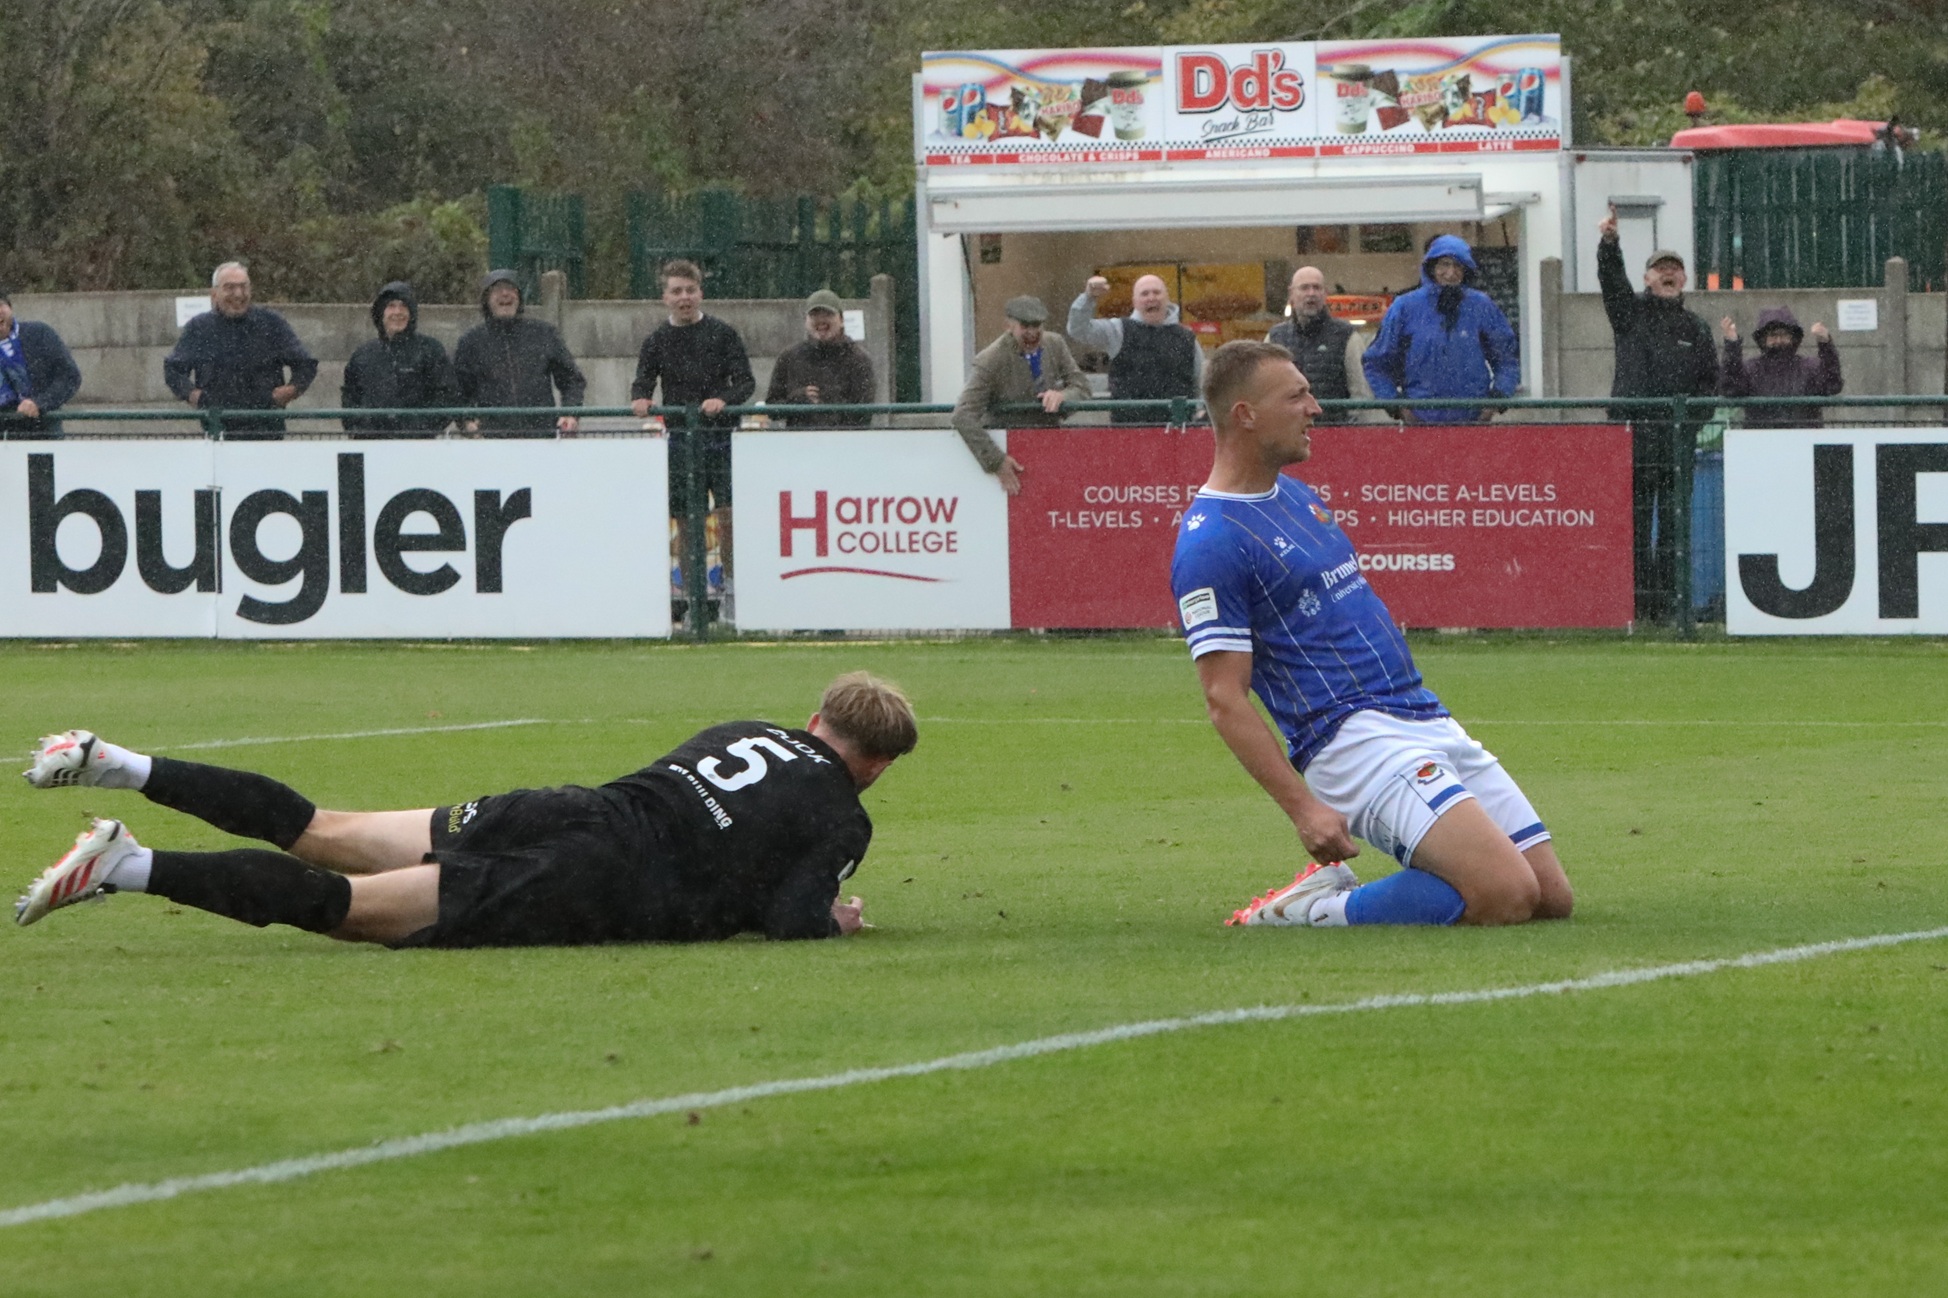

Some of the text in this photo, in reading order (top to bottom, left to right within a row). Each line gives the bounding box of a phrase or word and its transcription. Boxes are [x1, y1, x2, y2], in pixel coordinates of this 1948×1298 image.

[1176, 48, 1305, 114] Dd's
[1201, 111, 1274, 138] Snack Bar
[1205, 148, 1271, 159] AMERICANO
[1343, 144, 1415, 155] CAPPUCCINO
[1479, 142, 1513, 151] LATTE
[950, 156, 971, 164] TEA
[1018, 155, 1084, 163] CHOCOLATE
[1101, 152, 1139, 162] CRISPS
[1084, 486, 1180, 503] COURSES
[1361, 484, 1449, 501] SCIENCE
[1456, 484, 1556, 501] A-LEVELS
[779, 490, 959, 557] Harrow
[1048, 511, 1142, 528] T-LEVELS
[1388, 509, 1466, 526] HIGHER
[1472, 509, 1594, 526] EDUCATION
[27, 452, 532, 625] bugler
[837, 531, 958, 553] COLLEGE
[1358, 553, 1455, 571] COURSES
[697, 737, 799, 791] 5
